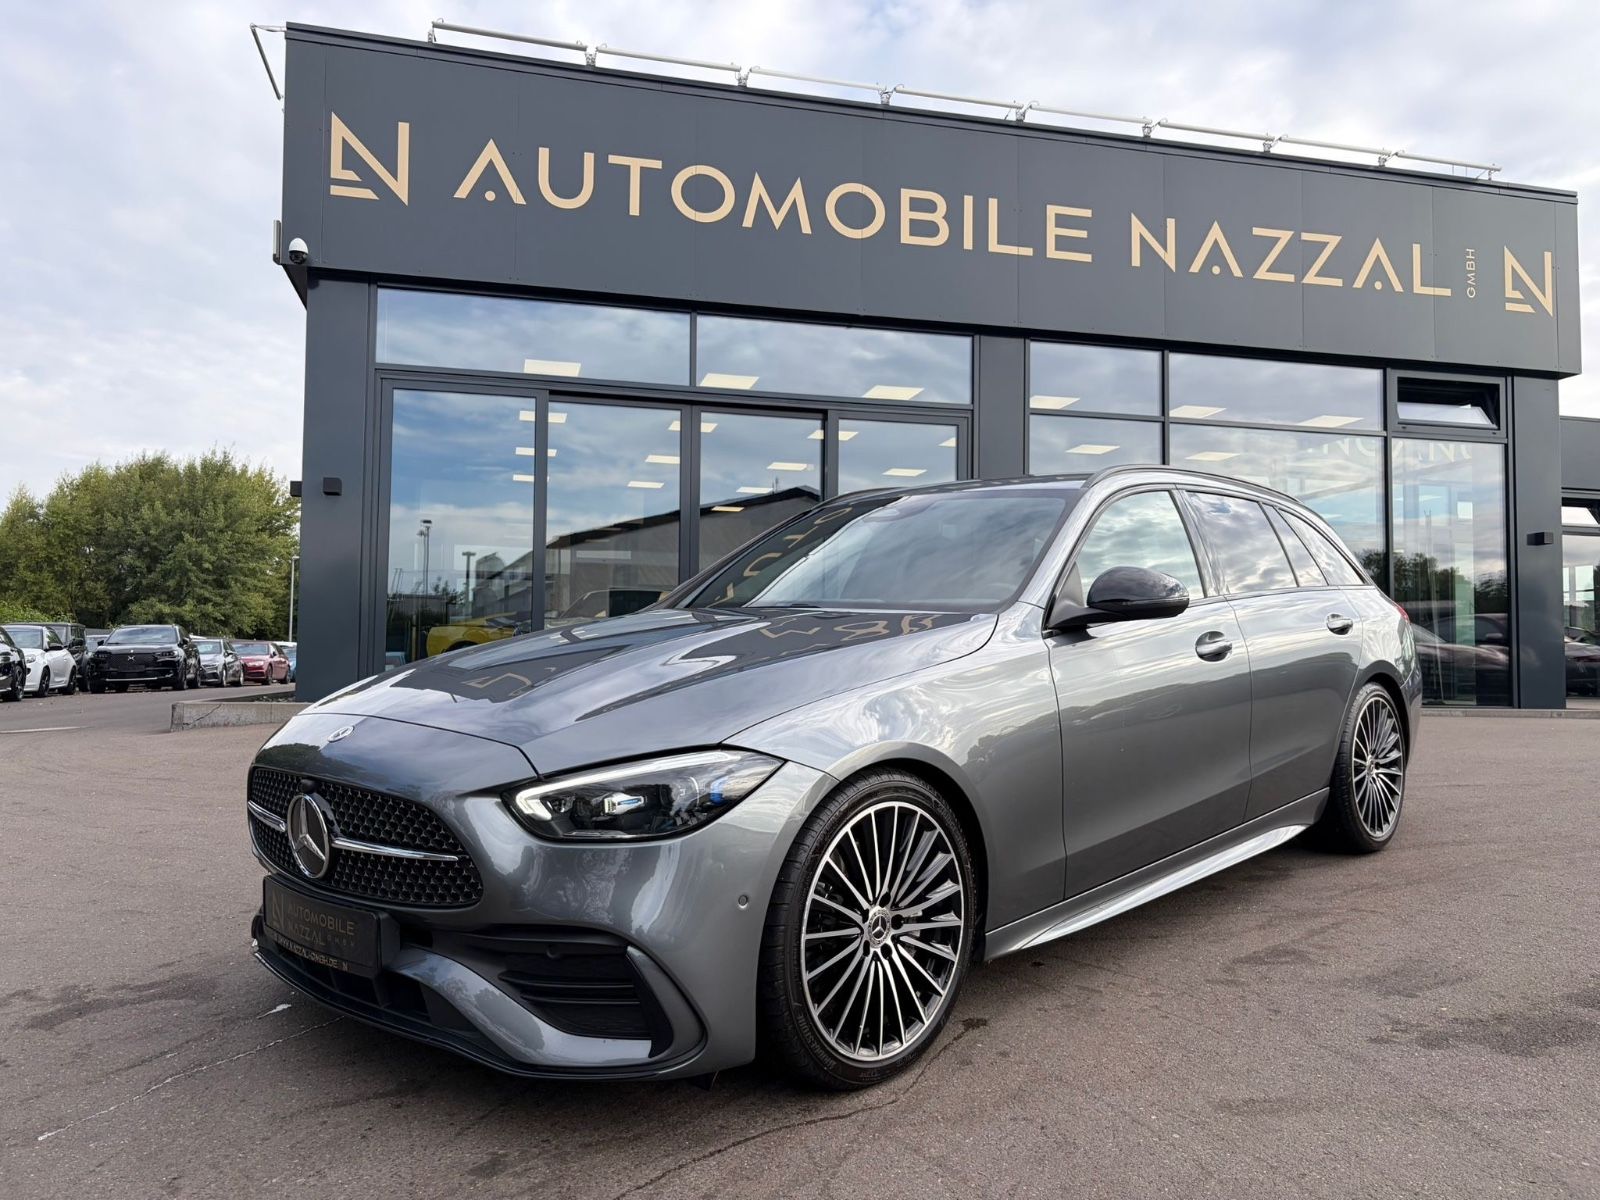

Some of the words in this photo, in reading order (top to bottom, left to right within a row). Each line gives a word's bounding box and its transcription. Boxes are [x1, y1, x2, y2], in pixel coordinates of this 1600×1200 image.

[330, 111, 410, 206] N
[453, 137, 1093, 263] AUTOMOBILE
[1131, 211, 1452, 298] NAZZAL
[1465, 248, 1476, 298] GMBH
[1504, 245, 1553, 317] N
[287, 902, 356, 936] AUTOMOBILE
[287, 920, 326, 946] NAZZAL
